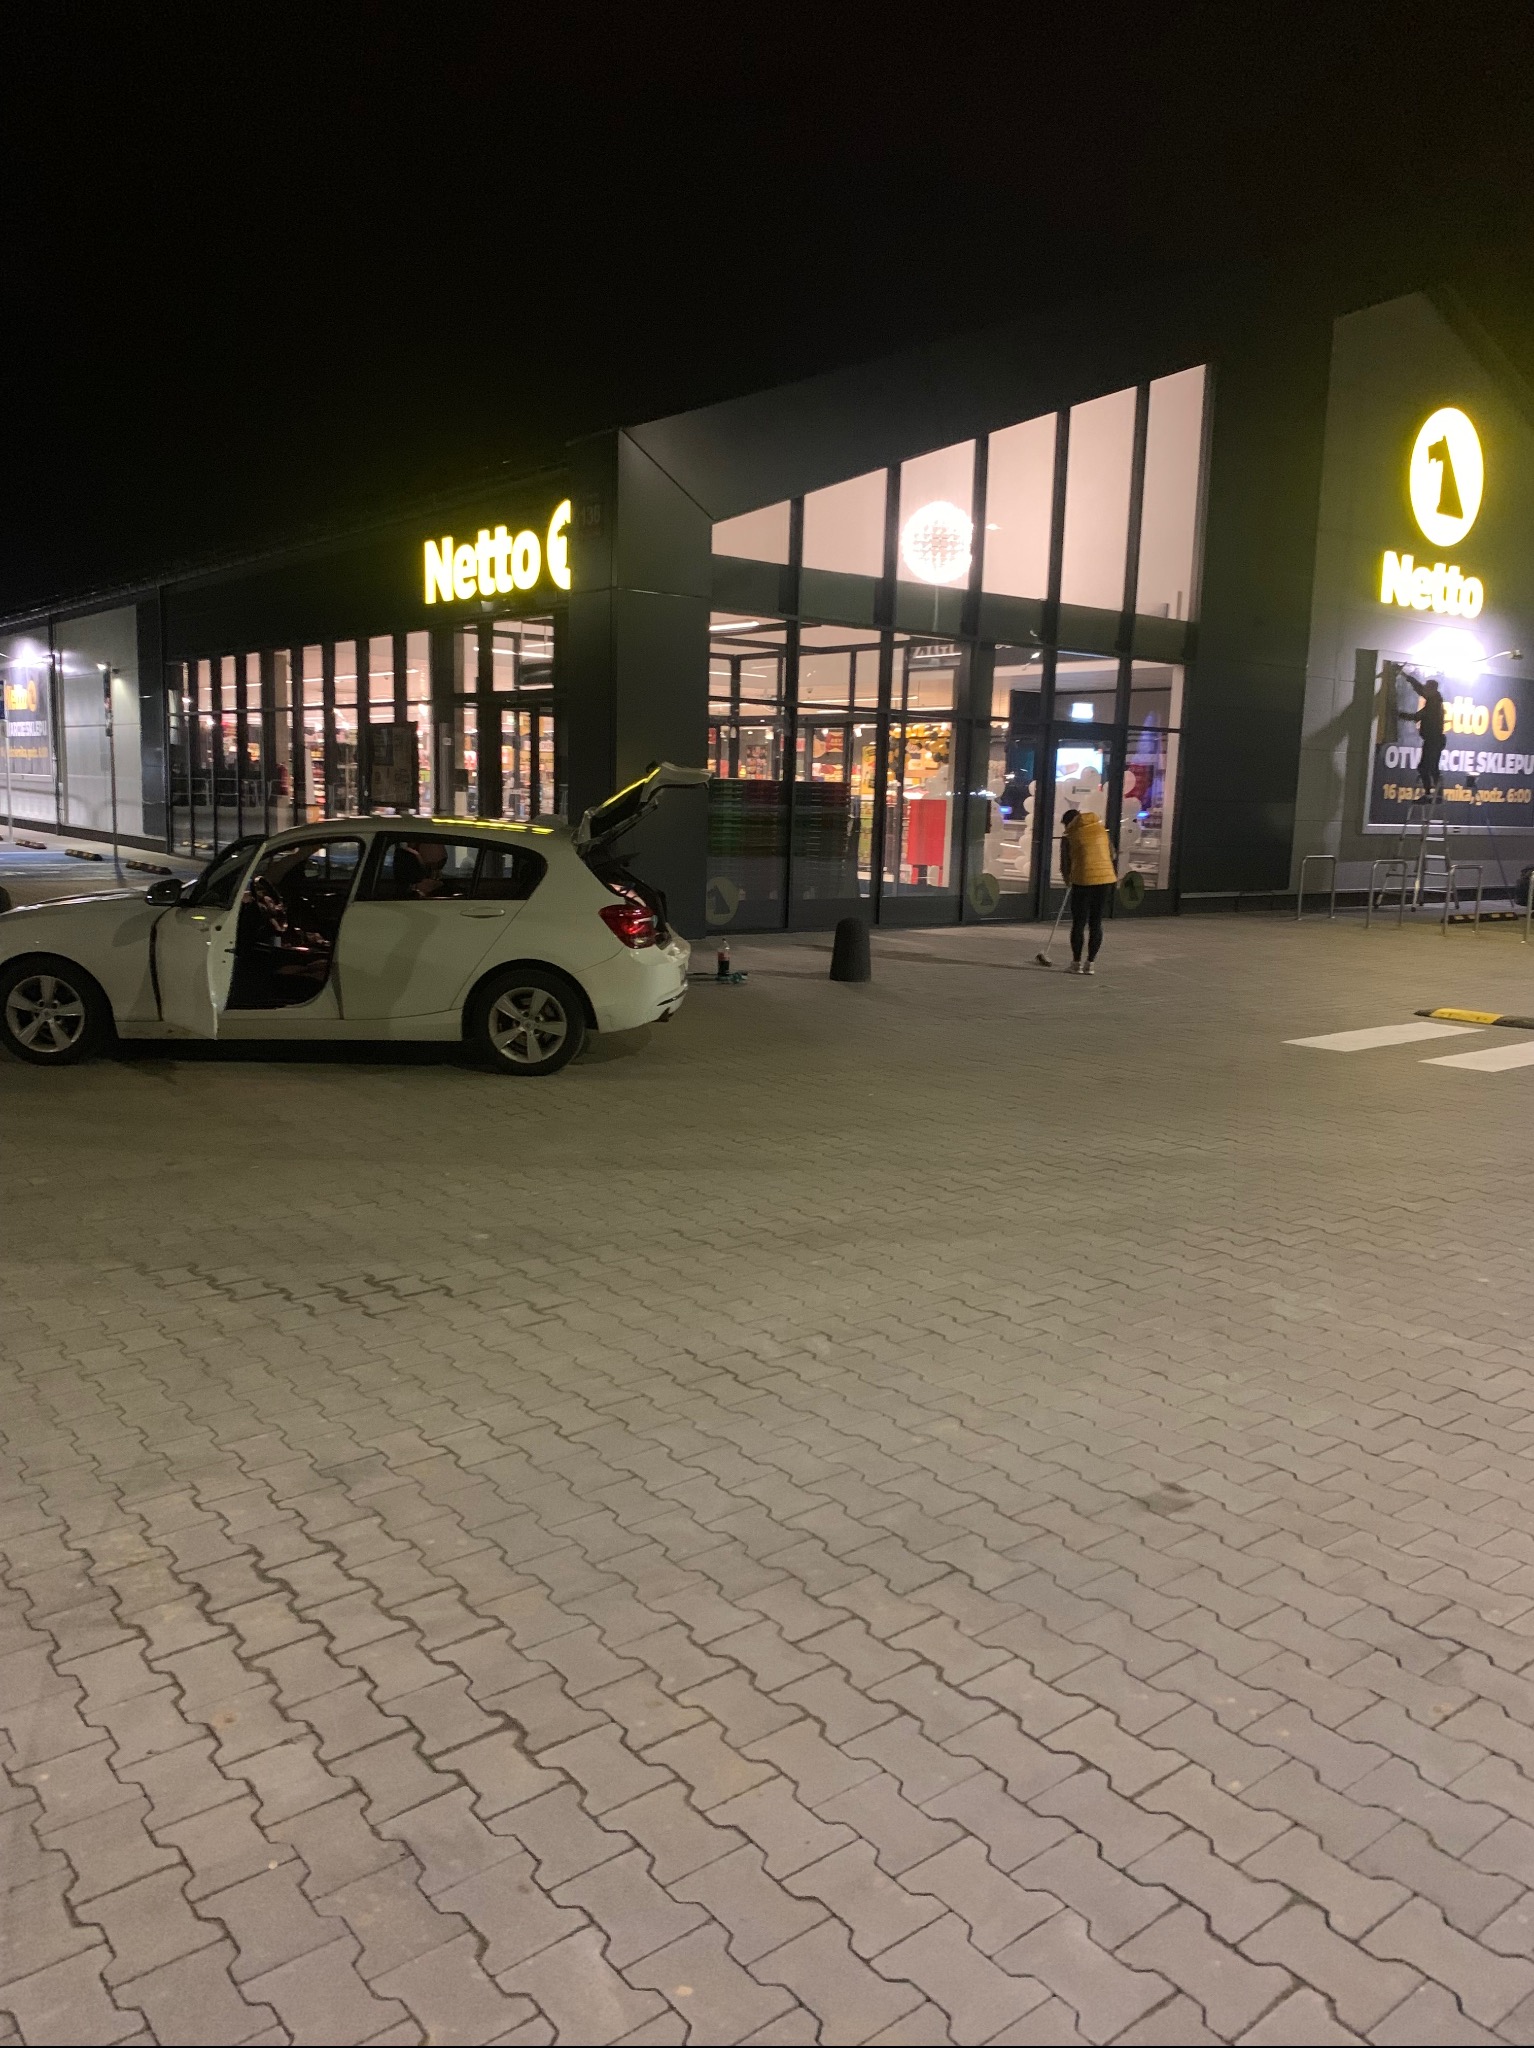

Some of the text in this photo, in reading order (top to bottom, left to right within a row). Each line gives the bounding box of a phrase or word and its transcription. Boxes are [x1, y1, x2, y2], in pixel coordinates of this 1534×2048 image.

[424, 525, 541, 604] Netto
[1380, 550, 1483, 618] Netto
[1413, 694, 1489, 735] etto
[1385, 745, 1534, 775] OTWRCIE SKLEPU
[1382, 783, 1397, 800] 16
[1476, 786, 1505, 806] godz.
[1506, 788, 1532, 804] 6:00
